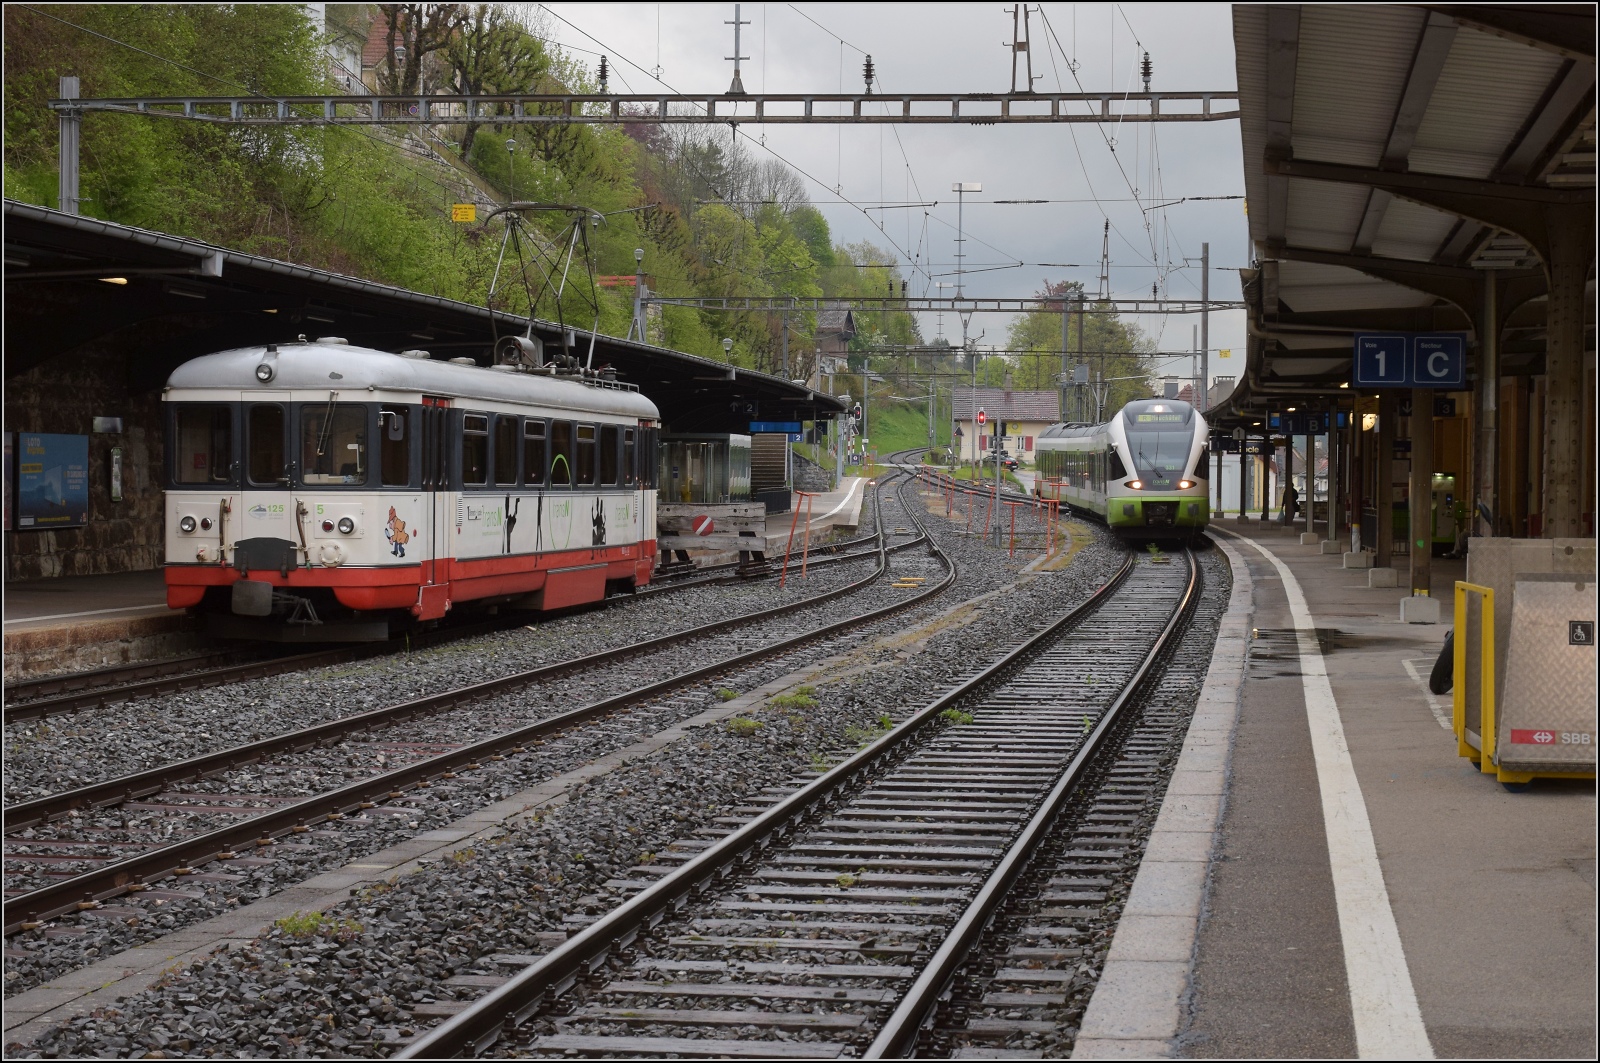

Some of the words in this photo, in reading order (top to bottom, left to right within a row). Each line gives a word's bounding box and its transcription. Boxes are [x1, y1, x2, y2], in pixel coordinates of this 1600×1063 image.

[1375, 350, 1386, 377] 1
[1427, 351, 1449, 378] C
[746, 403, 753, 412] 2
[1442, 404, 1450, 414] 3
[1287, 419, 1293, 432] 1
[1309, 419, 1319, 432] B
[267, 504, 284, 513] 125
[317, 504, 324, 515] 5
[1561, 732, 1591, 745] SBB
